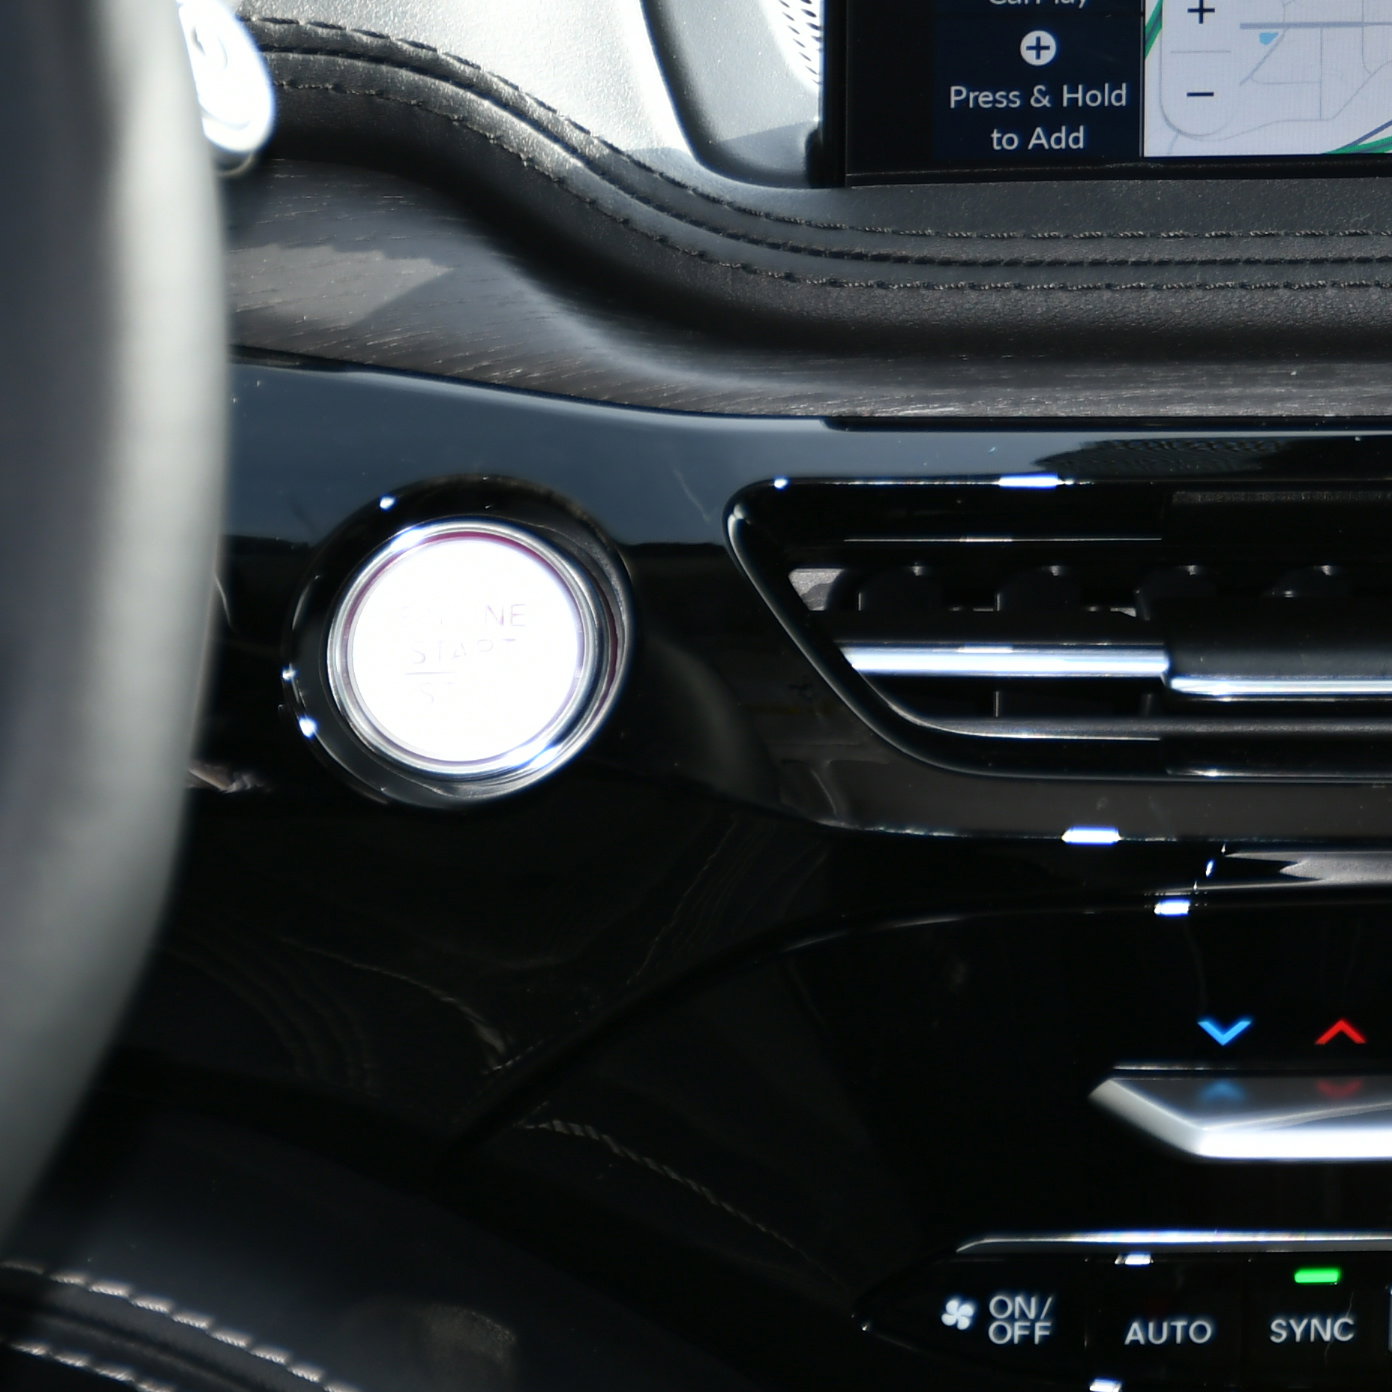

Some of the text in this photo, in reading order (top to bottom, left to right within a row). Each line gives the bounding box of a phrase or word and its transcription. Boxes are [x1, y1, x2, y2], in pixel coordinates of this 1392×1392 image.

[950, 83, 1127, 108] Press & Hold
[991, 126, 1085, 150] to Add
[989, 1295, 1054, 1321] ON/
[988, 1321, 1054, 1346] OFF
[1124, 1320, 1213, 1347] AUTO
[1270, 1316, 1357, 1344] SYNC
